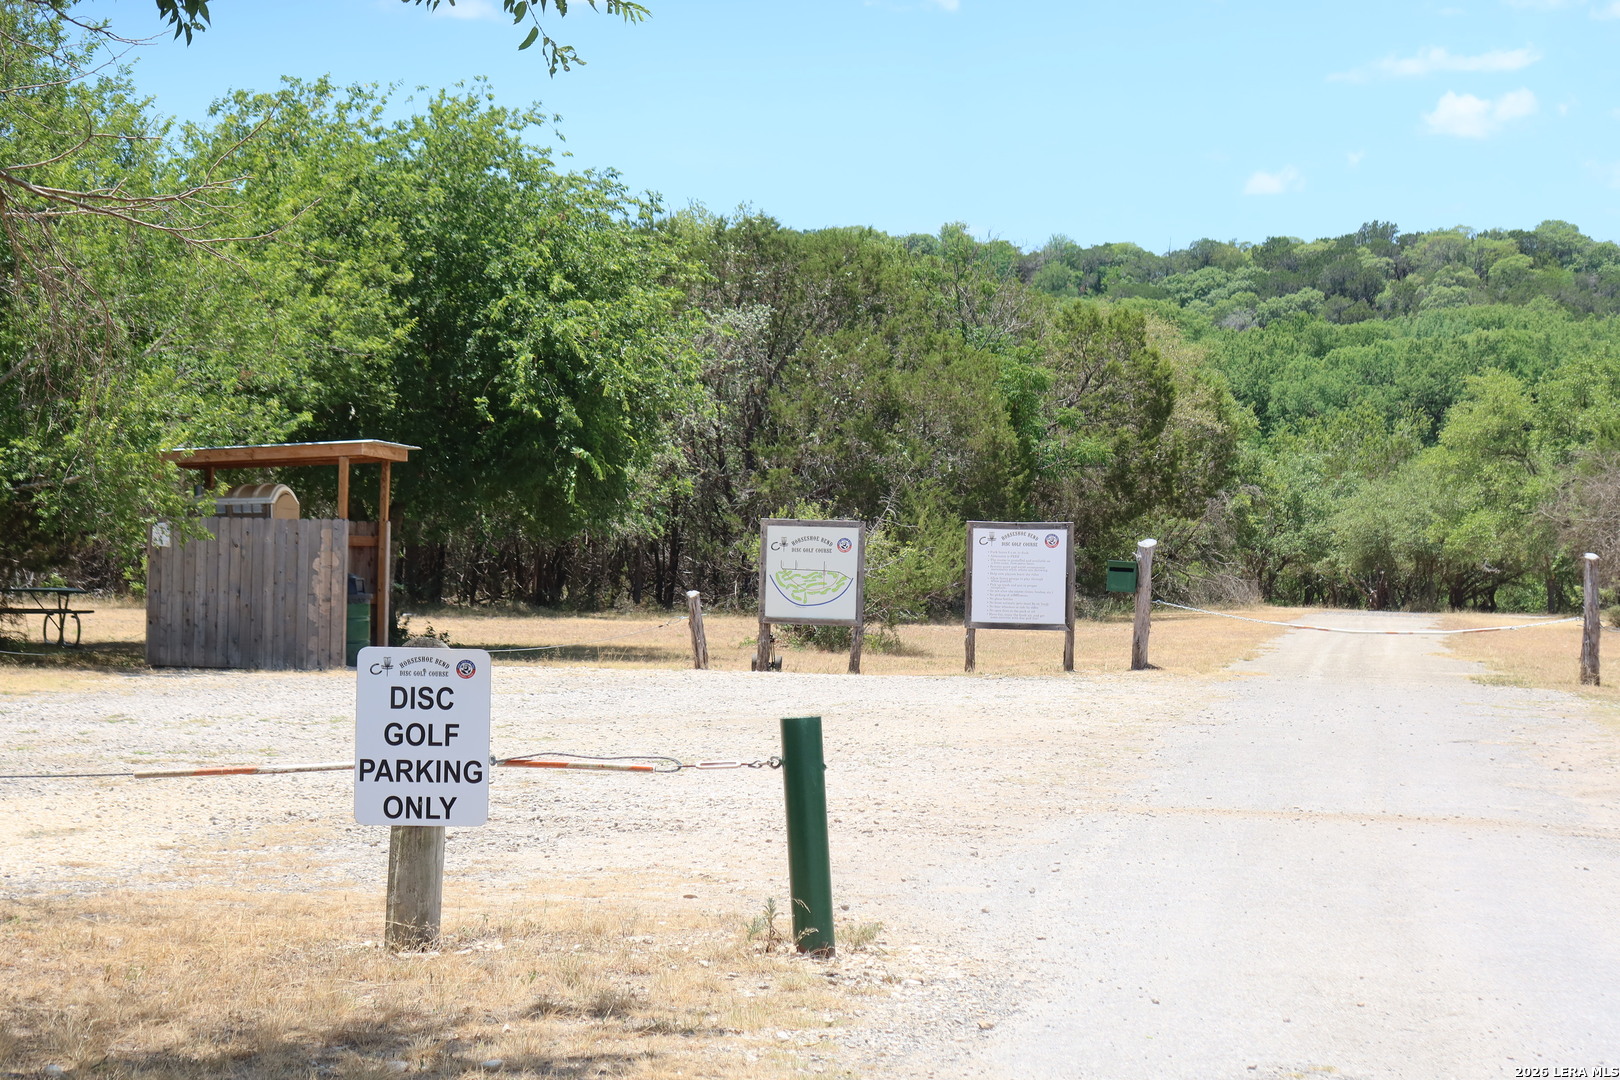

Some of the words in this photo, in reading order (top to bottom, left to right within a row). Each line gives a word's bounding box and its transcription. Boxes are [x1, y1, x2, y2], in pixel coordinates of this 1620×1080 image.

[399, 656, 434, 668] HORSESHOE
[434, 658, 450, 670] BEND
[390, 686, 454, 710] DISC
[384, 722, 460, 747] GOLF
[359, 758, 483, 784] PARKING
[383, 796, 457, 820] ONLY
